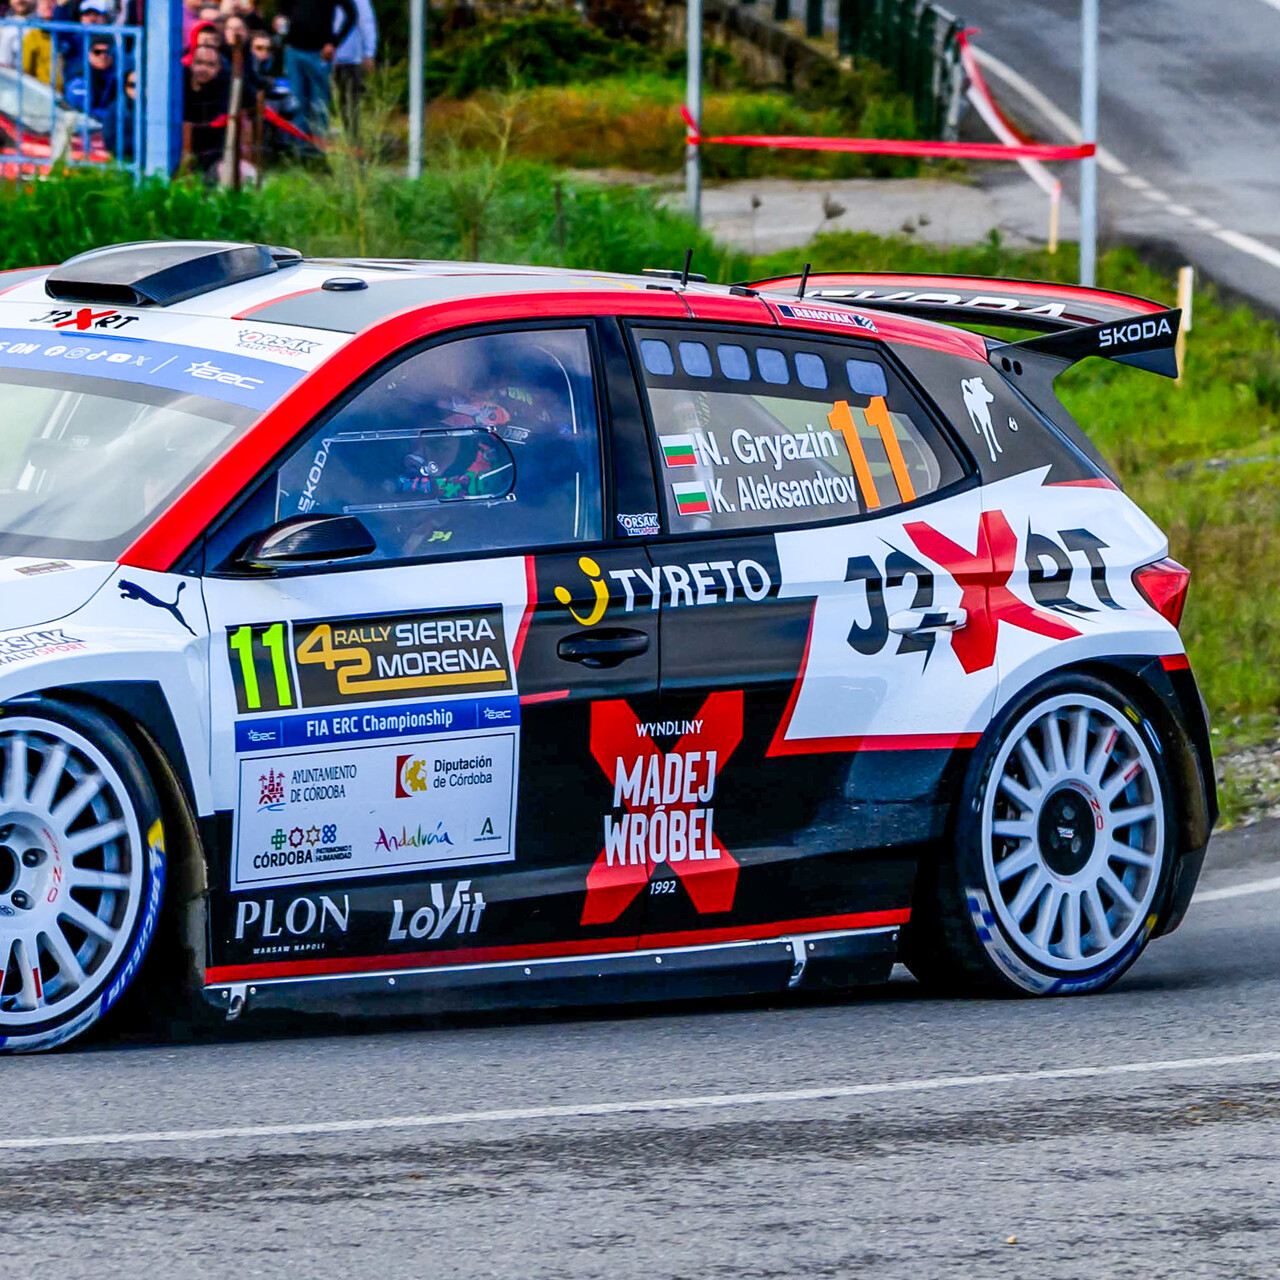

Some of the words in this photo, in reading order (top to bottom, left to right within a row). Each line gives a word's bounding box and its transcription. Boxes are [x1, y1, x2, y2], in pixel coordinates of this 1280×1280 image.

[793, 306, 852, 324] RENOVAK
[13, 342, 40, 356] ON
[239, 331, 322, 354] ORSAK
[695, 431, 730, 466] N.
[731, 423, 840, 471] Gryazin
[826, 395, 917, 509] 11
[709, 478, 736, 513] K.
[736, 470, 857, 512] Aleksandrov
[623, 515, 658, 528] ORSAK
[609, 558, 772, 612] TYRETO
[333, 625, 392, 646] RALLY
[395, 618, 497, 648] SIERRA
[229, 622, 293, 710] 11
[376, 646, 503, 679] MORENA
[306, 720, 329, 738] FIA
[333, 717, 359, 735] ERC
[362, 708, 454, 733] Championship
[635, 718, 704, 738] WYNDLINY
[290, 764, 358, 785] AYUNTAMIENTO
[434, 755, 493, 774] Diputación
[433, 774, 445, 789] de
[446, 772, 493, 788] Córdoba
[612, 750, 718, 809] MADEJ
[290, 787, 302, 803] DE
[303, 783, 347, 802] CÓRDOBA
[374, 821, 455, 853] Andalucía
[604, 803, 721, 868] WRÓBEL
[253, 847, 314, 869] CÓRDOBA
[649, 879, 677, 896] 1992
[233, 894, 351, 940] PLON
[252, 945, 291, 955] WARSAW
[293, 942, 326, 953] NAPOLI
